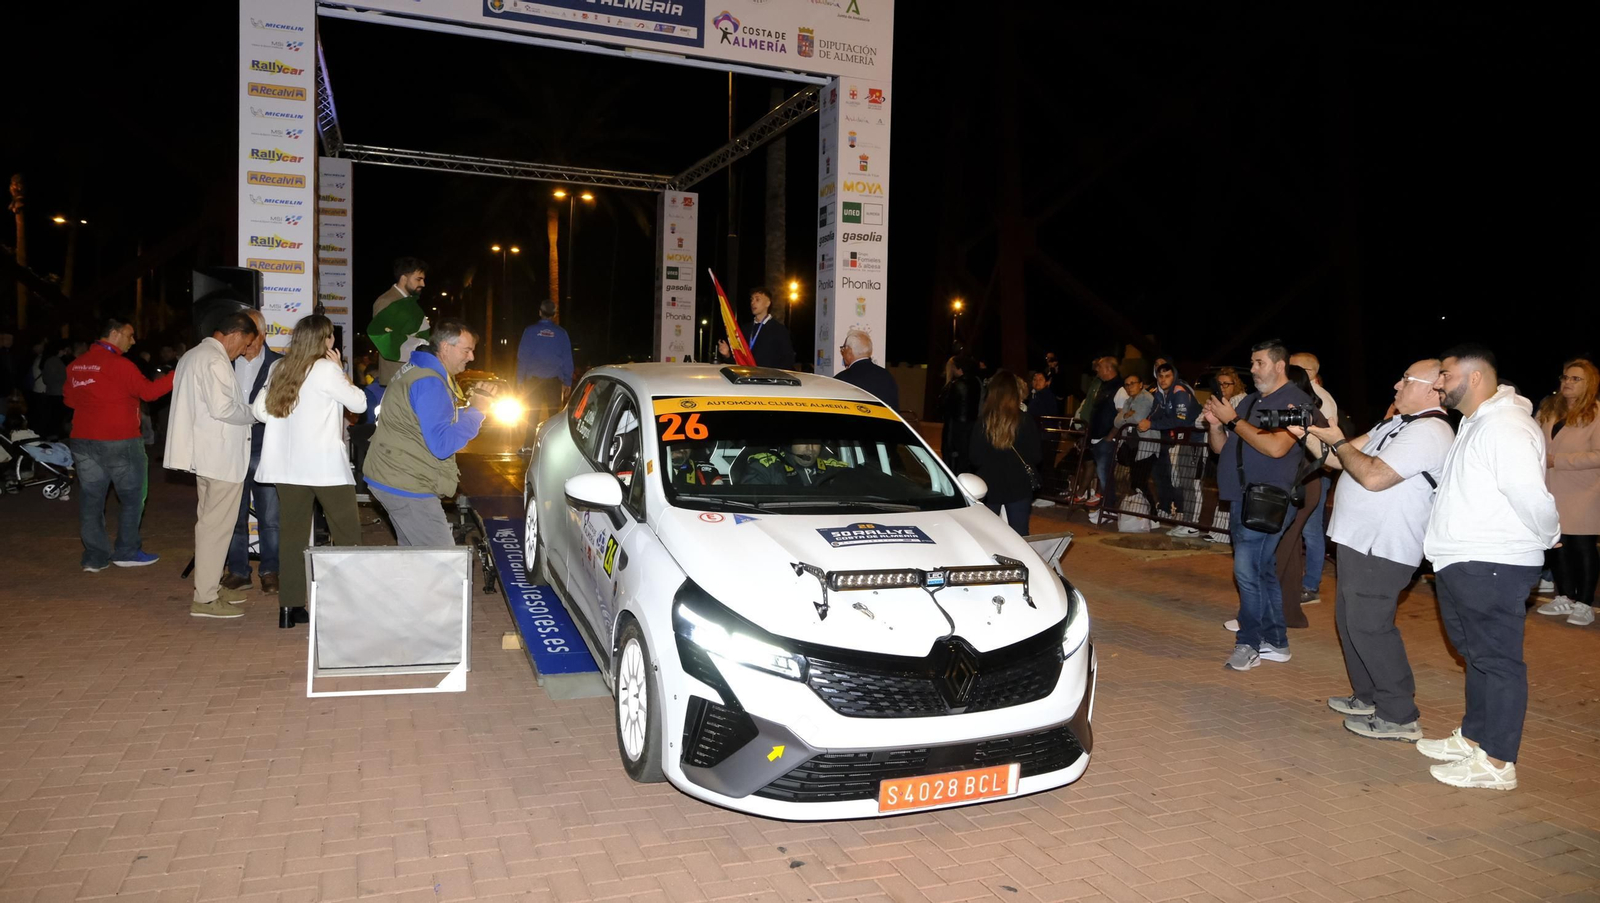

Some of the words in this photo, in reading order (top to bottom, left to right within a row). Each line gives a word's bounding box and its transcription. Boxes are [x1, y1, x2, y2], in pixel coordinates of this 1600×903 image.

[265, 22, 303, 31] MICHELIN
[742, 26, 773, 38] COSTA
[775, 32, 787, 41] DE
[733, 36, 787, 54] ALMERÍA
[819, 39, 877, 57] DIPUTACIÓN
[819, 50, 832, 60] DE
[833, 53, 874, 67] ALMERÍA
[251, 59, 304, 75] Rallycar
[259, 85, 295, 98] Recalvi
[265, 111, 303, 120] MICHELIN
[251, 148, 304, 164] Rallycar
[259, 174, 294, 186] Recalvi
[264, 198, 302, 206] MICHELIN
[250, 235, 303, 250] Rallycar
[842, 231, 882, 243] gasolia
[258, 260, 293, 271] Recalvi
[262, 285, 301, 293] MICHELIN
[842, 277, 881, 290] Phonika
[666, 312, 692, 321] Phonika
[810, 402, 850, 410] ALMERÍA
[659, 413, 709, 441] 26
